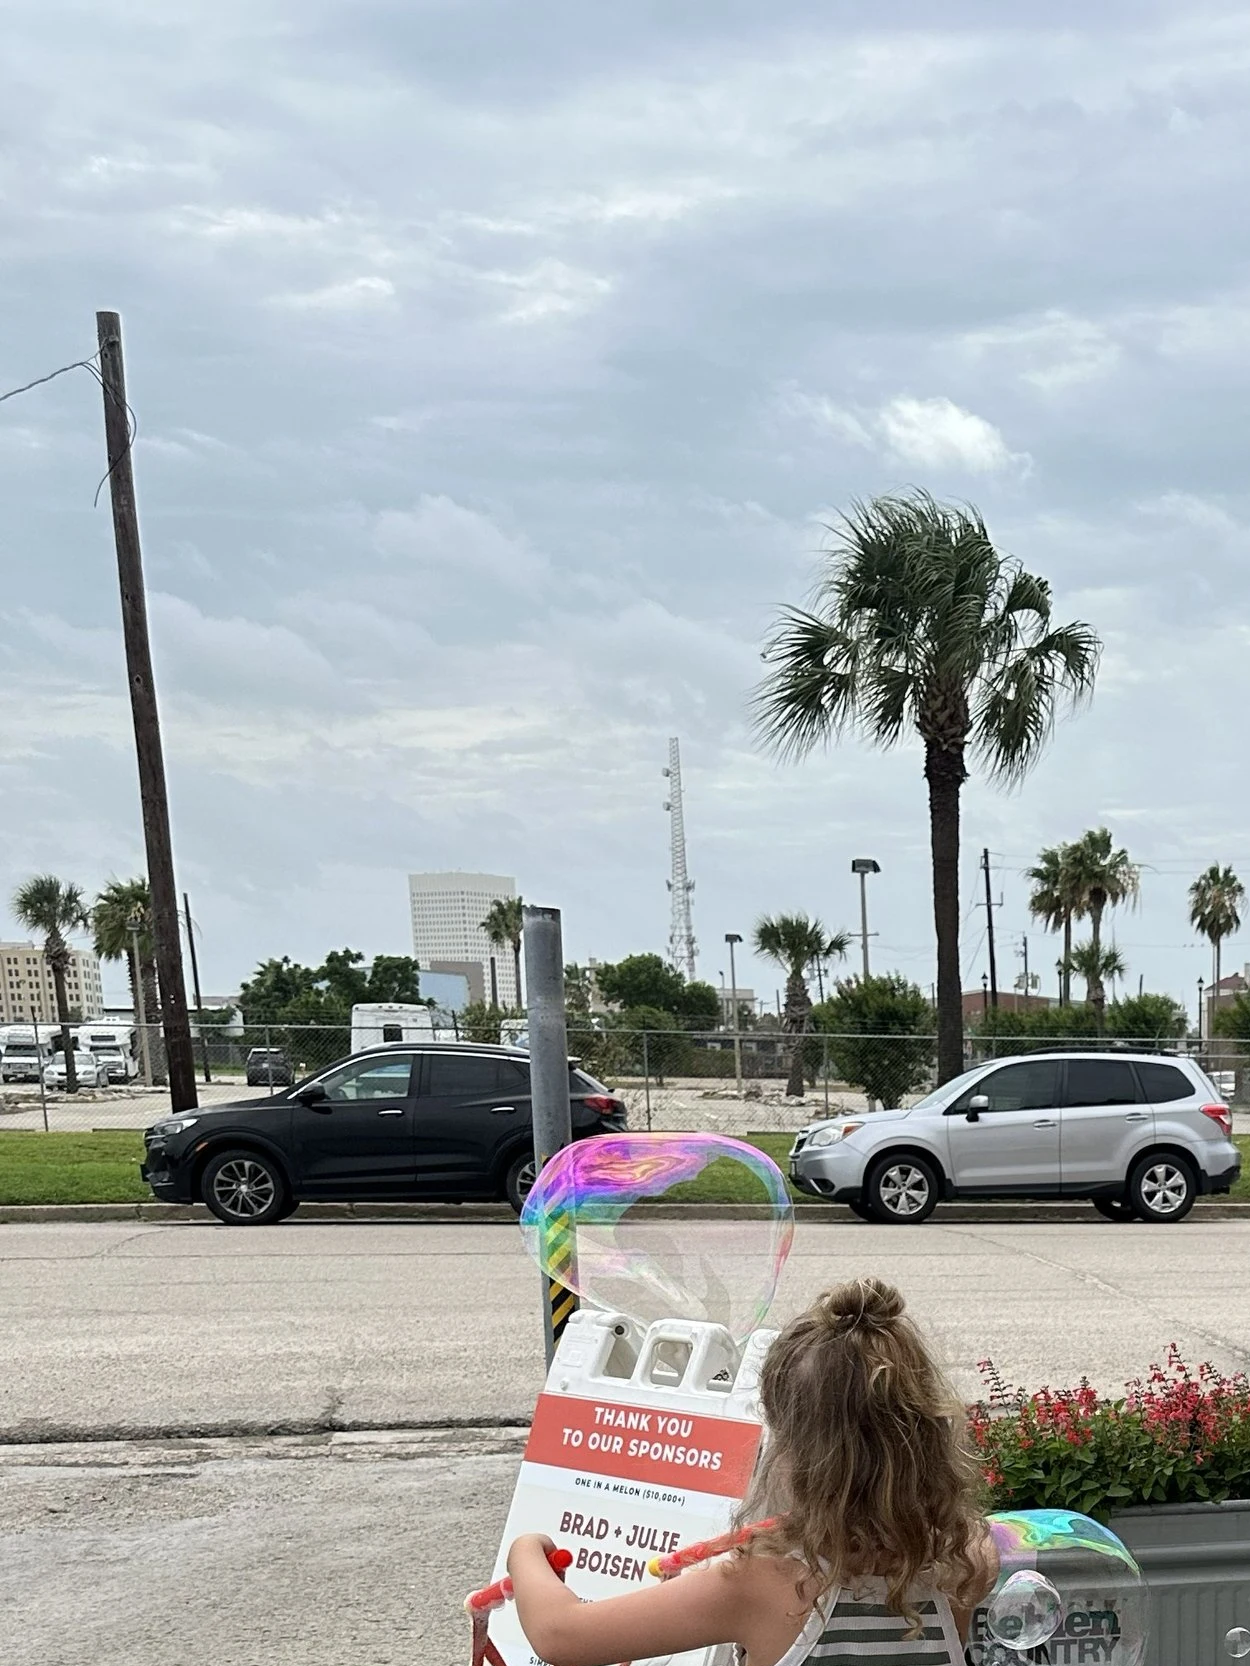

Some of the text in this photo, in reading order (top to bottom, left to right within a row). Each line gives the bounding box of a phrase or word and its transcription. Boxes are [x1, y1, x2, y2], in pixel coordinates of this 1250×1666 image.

[594, 1406, 693, 1438] THANK YOU
[562, 1428, 723, 1471] TO OUR SPONSORS
[575, 1477, 686, 1507] ONE IN A MELON ($10,000+)
[560, 1511, 681, 1554] BRAD + JULIE
[575, 1547, 647, 1582] BOISEN
